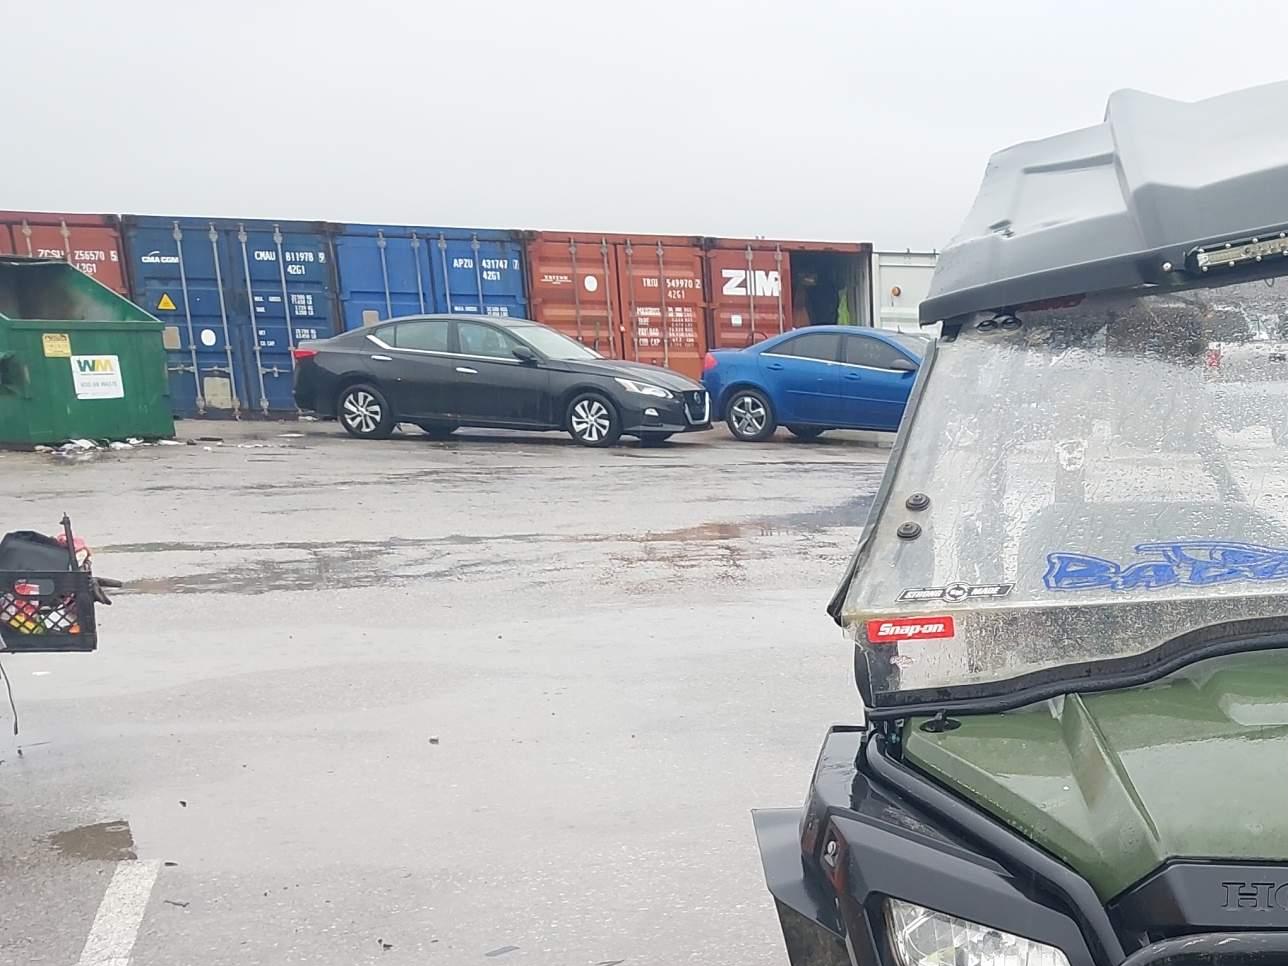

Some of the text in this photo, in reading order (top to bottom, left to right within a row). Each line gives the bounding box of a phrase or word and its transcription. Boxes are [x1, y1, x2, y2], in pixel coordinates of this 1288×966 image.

[254, 251, 276, 261] CMAU
[453, 258, 473, 269] APZU
[482, 258, 508, 269] 431747
[721, 268, 781, 297] ZIM
[76, 359, 114, 372] WM
[877, 622, 945, 637] Snap-on
